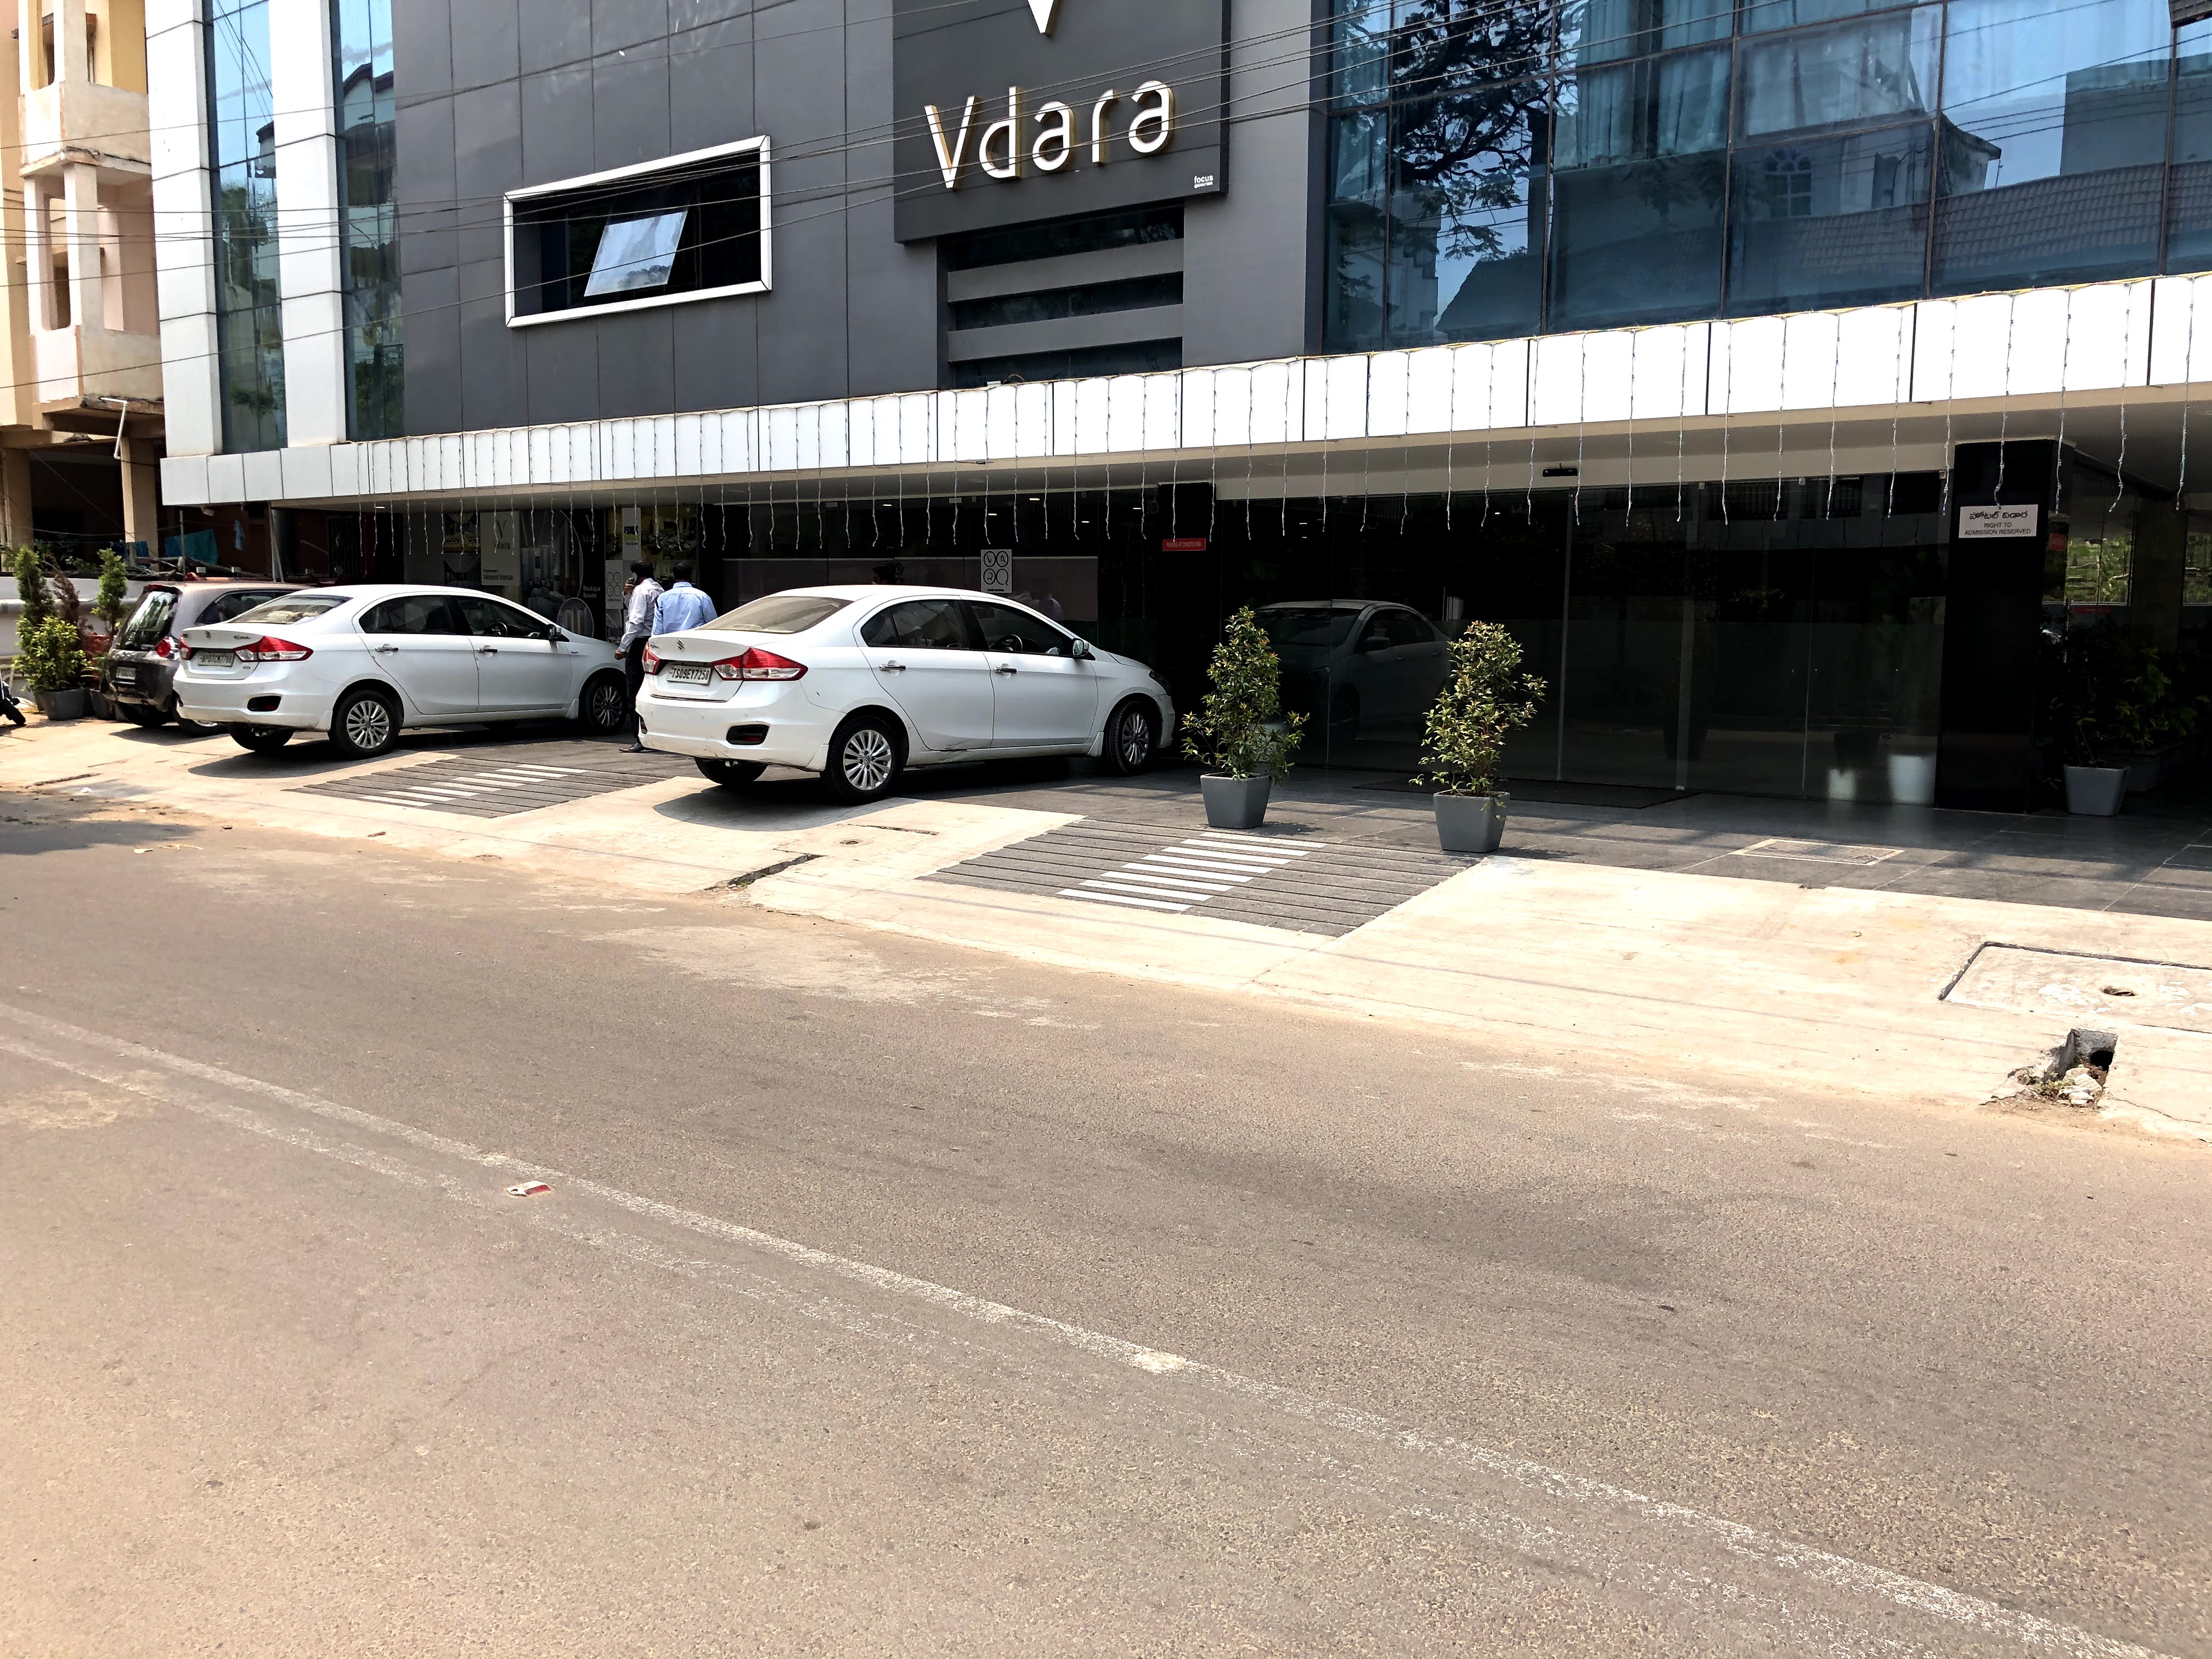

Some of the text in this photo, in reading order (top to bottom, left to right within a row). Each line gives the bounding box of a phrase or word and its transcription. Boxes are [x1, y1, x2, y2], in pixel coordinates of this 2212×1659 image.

[924, 80, 1173, 189] Vdara
[1194, 175, 1214, 184] focus
[672, 668, 709, 680] TS09EY7258
